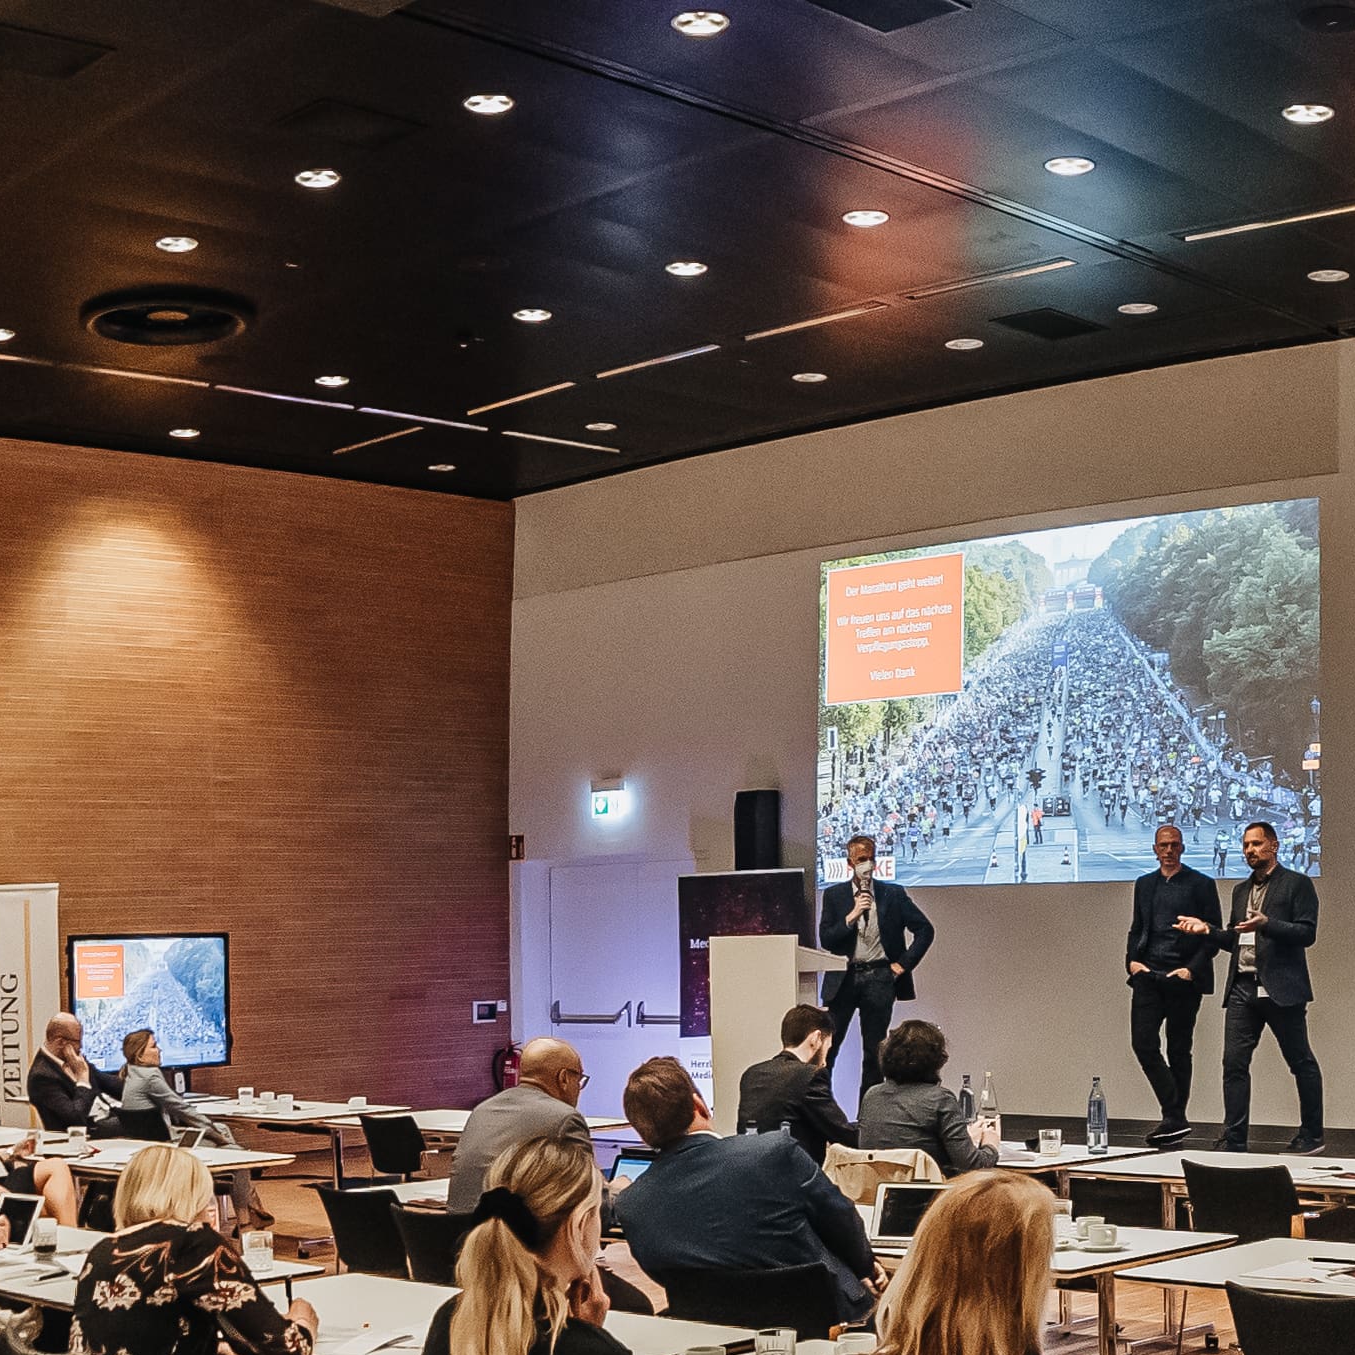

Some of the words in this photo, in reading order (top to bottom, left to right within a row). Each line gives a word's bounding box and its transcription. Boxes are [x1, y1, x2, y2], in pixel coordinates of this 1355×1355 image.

[845, 585, 859, 597] Der
[860, 582, 897, 596] Marathon
[898, 579, 916, 592] geht
[875, 611, 891, 623] uns
[891, 608, 905, 620] auf
[905, 607, 920, 619] das
[895, 666, 916, 679] Dank
[846, 860, 893, 879] FKE
[0, 972, 23, 1102] ZEITUNG
